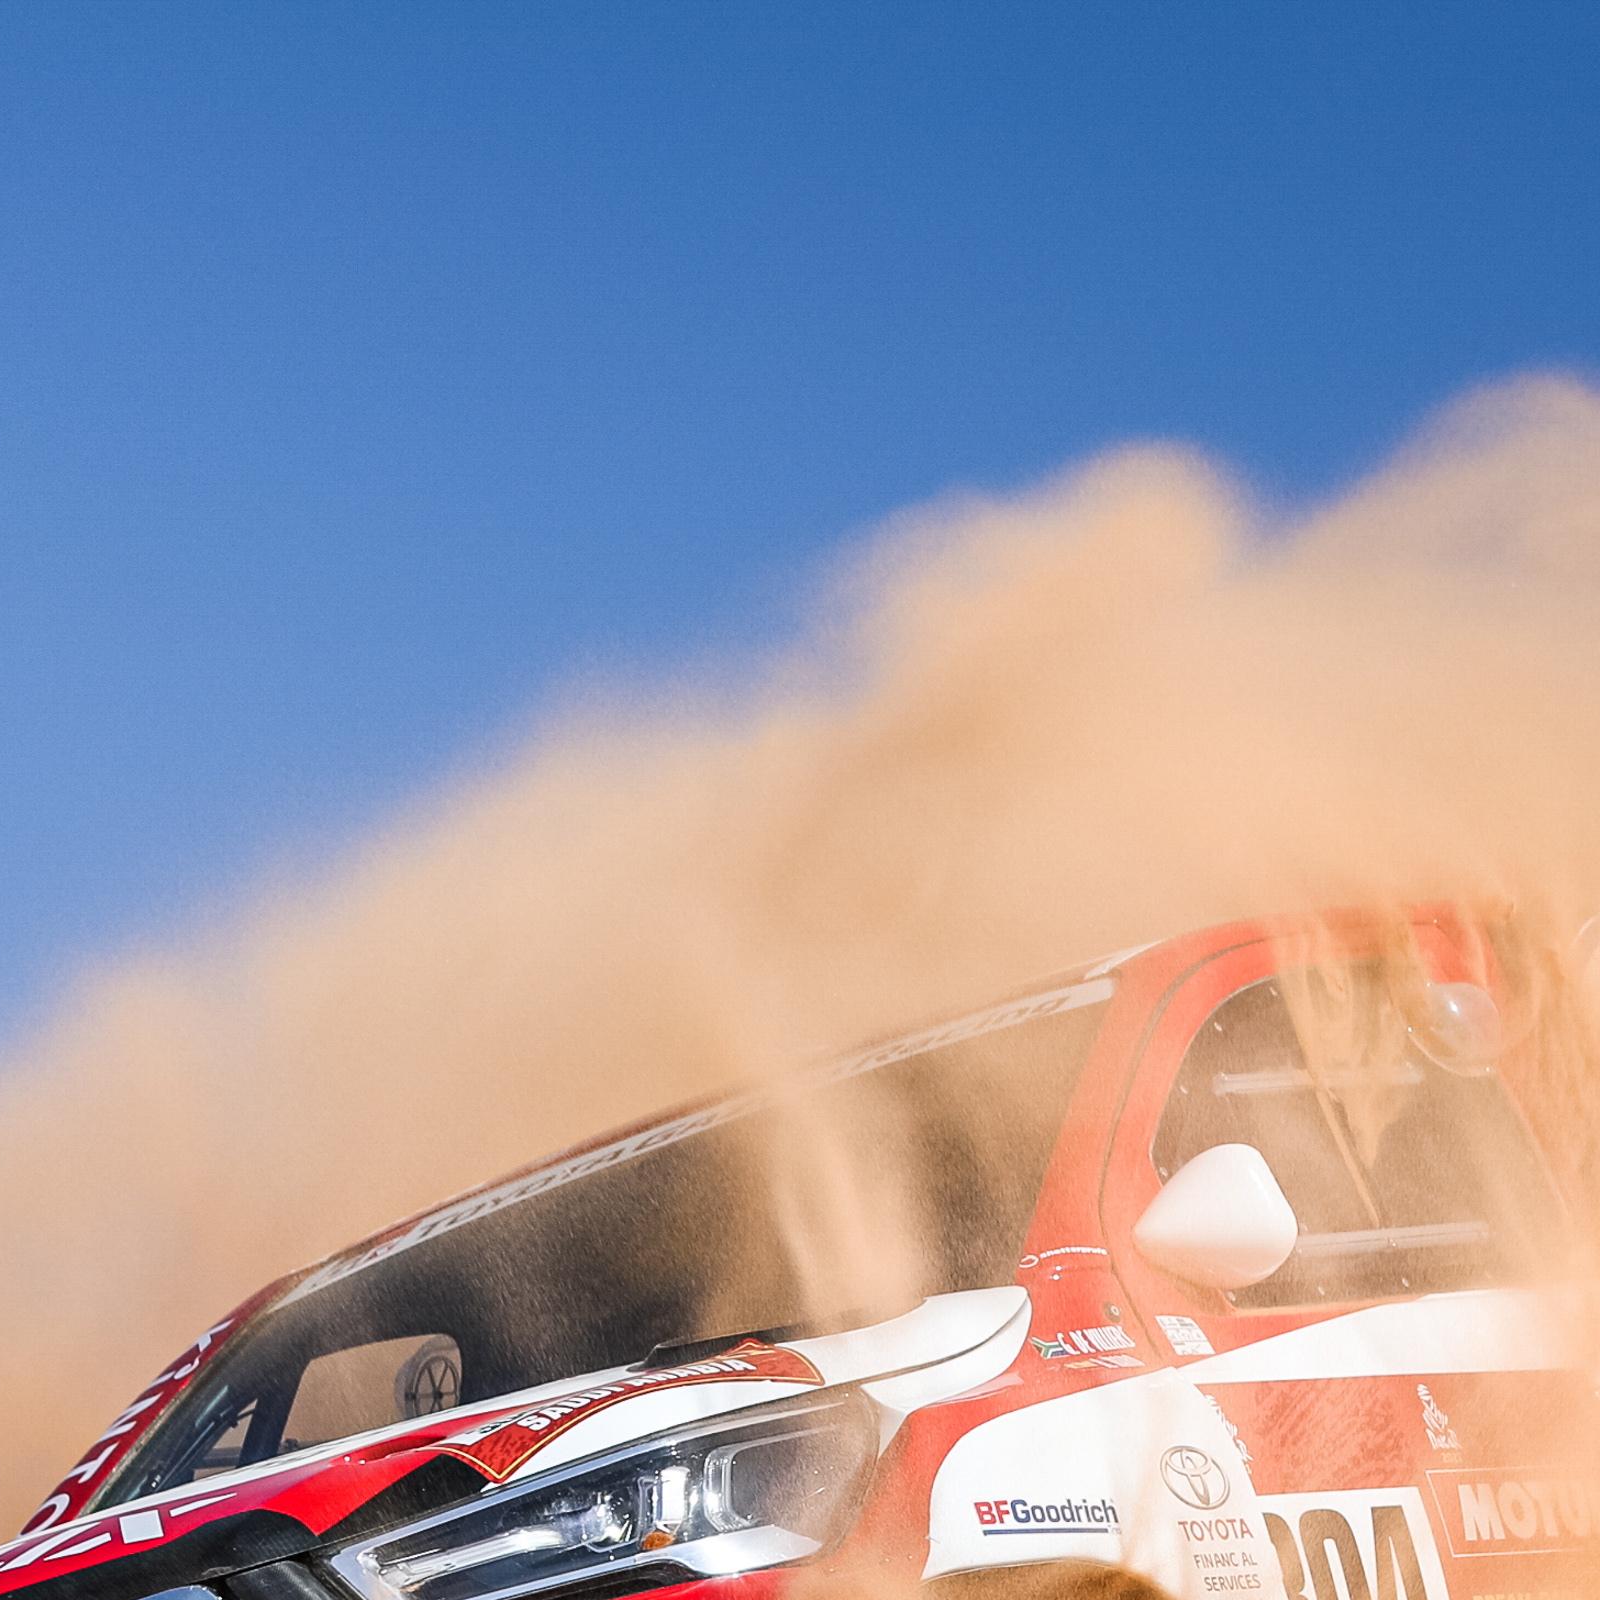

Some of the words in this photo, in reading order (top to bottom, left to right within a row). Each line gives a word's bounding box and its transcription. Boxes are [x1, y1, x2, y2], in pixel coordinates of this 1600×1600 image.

[517, 1385, 626, 1431] SAUDI
[974, 1499, 1119, 1525] BFGoodrich
[1178, 1518, 1253, 1542] TOYOTA
[1193, 1552, 1258, 1568] FINANCAL
[1203, 1573, 1261, 1592] SERVICES
